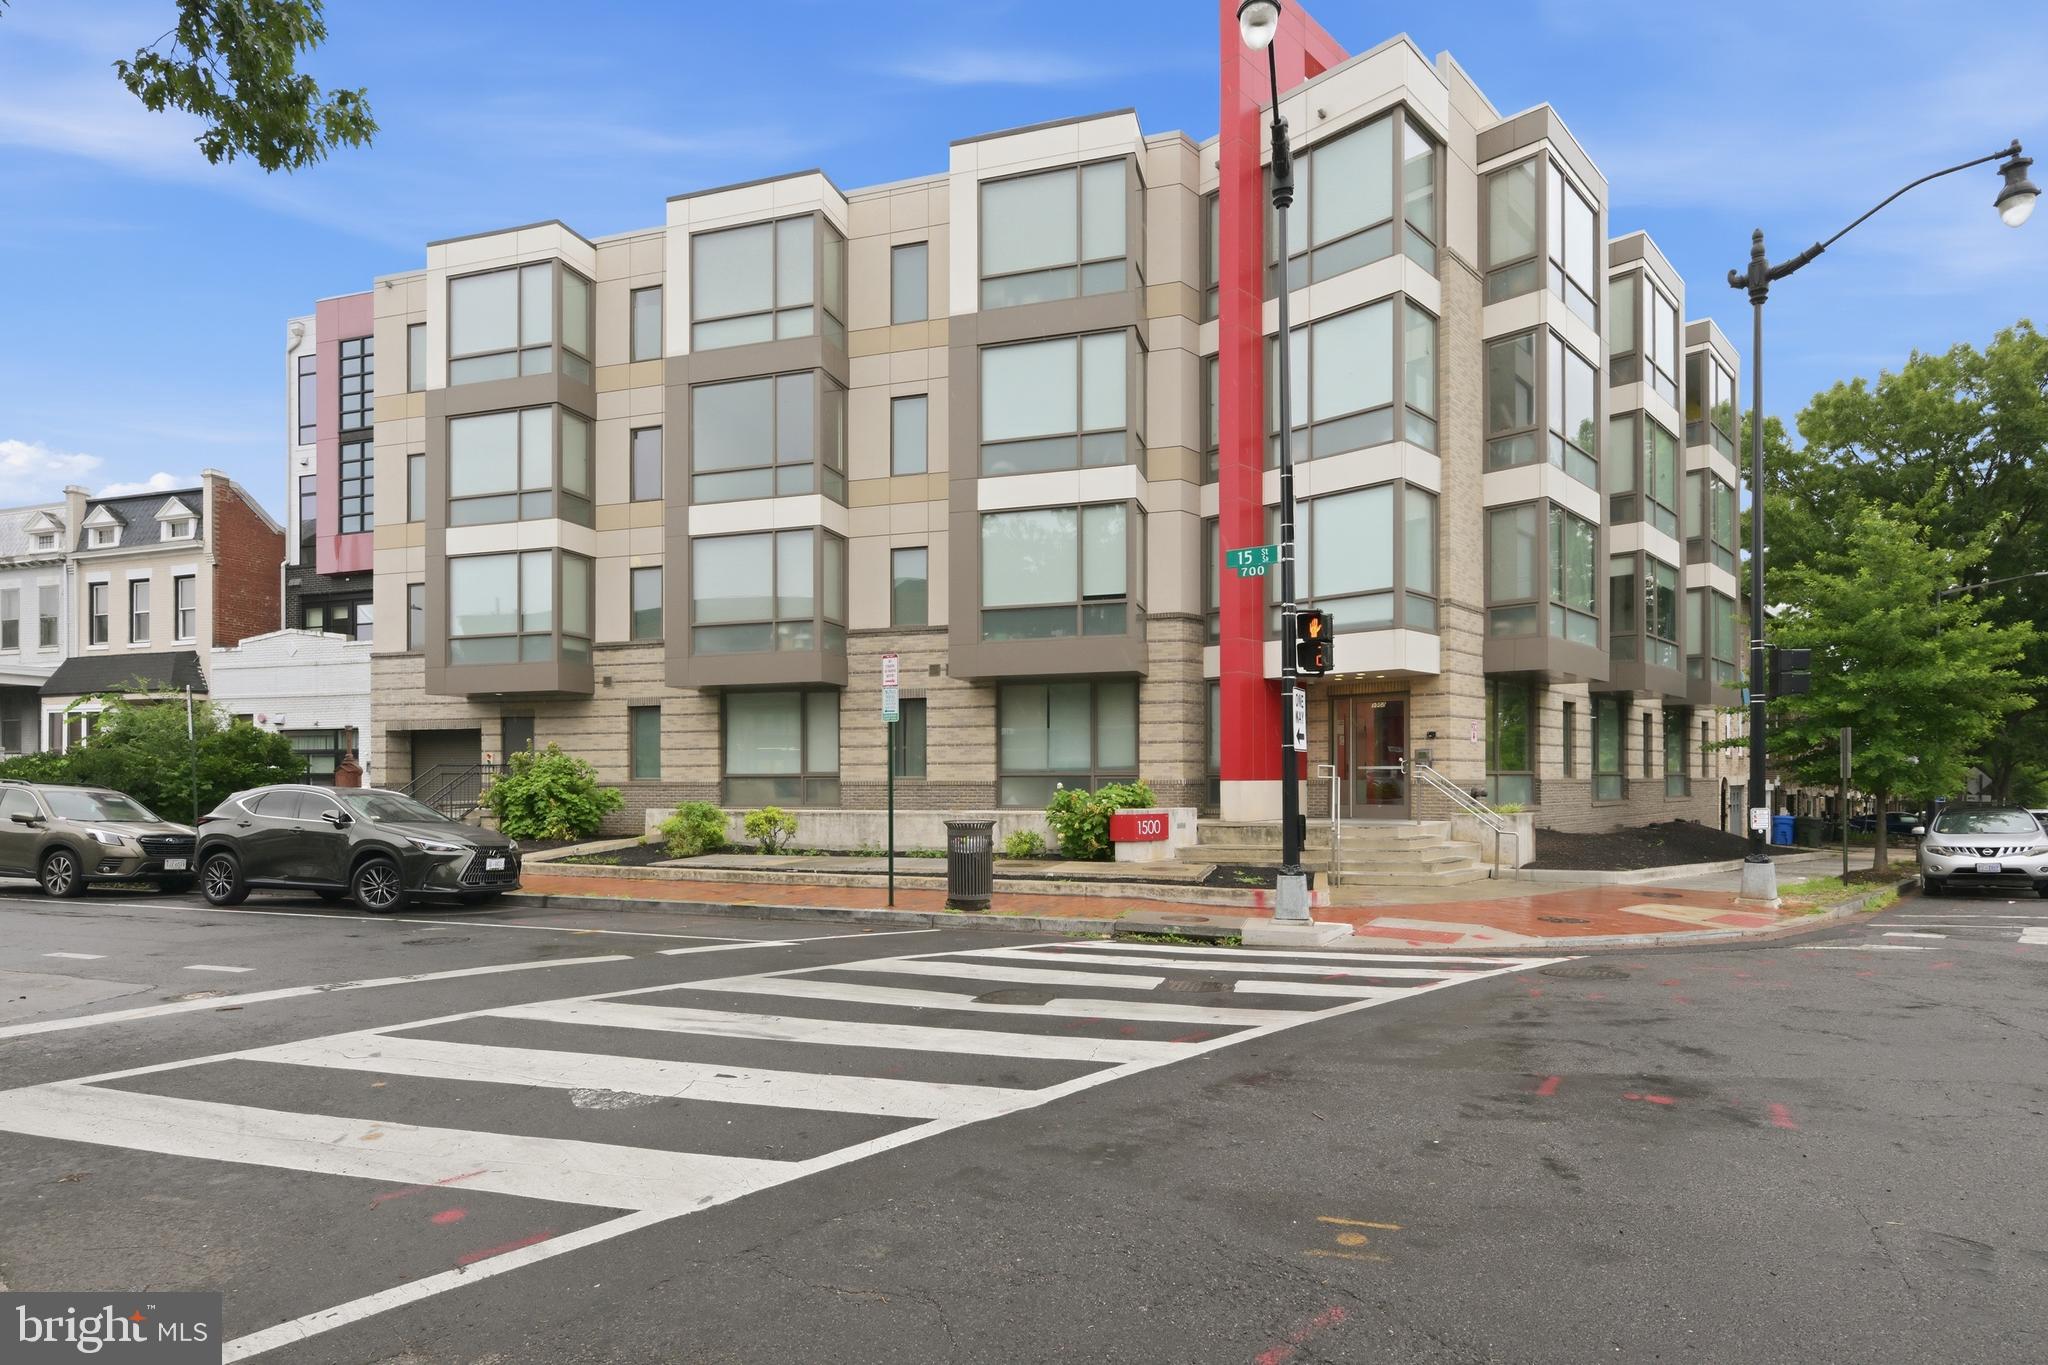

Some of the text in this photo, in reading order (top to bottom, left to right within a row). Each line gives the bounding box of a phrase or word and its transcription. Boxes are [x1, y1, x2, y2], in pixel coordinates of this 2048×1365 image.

[1237, 550, 1253, 565] 15
[1241, 565, 1265, 577] 700
[1137, 819, 1161, 835] 1500
